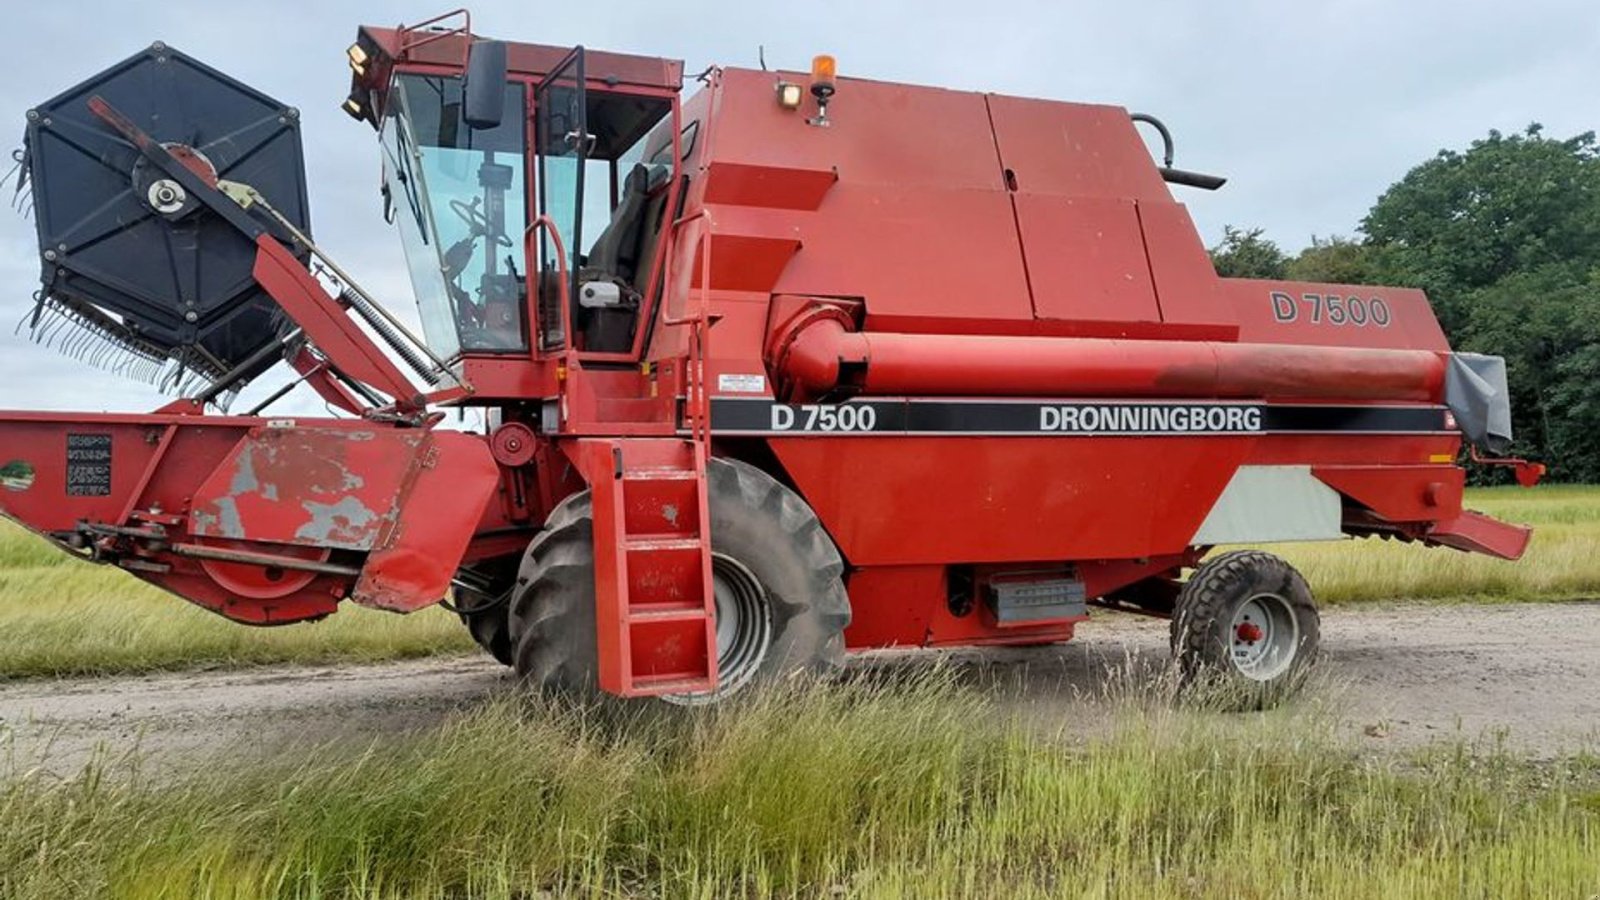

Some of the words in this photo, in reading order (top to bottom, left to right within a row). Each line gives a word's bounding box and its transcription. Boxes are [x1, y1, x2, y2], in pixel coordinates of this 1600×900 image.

[1270, 291, 1298, 322] D
[1302, 293, 1391, 327] 7500
[771, 404, 794, 430] D
[801, 405, 876, 431] 7500
[1040, 406, 1261, 431] DRONNINGBORG
